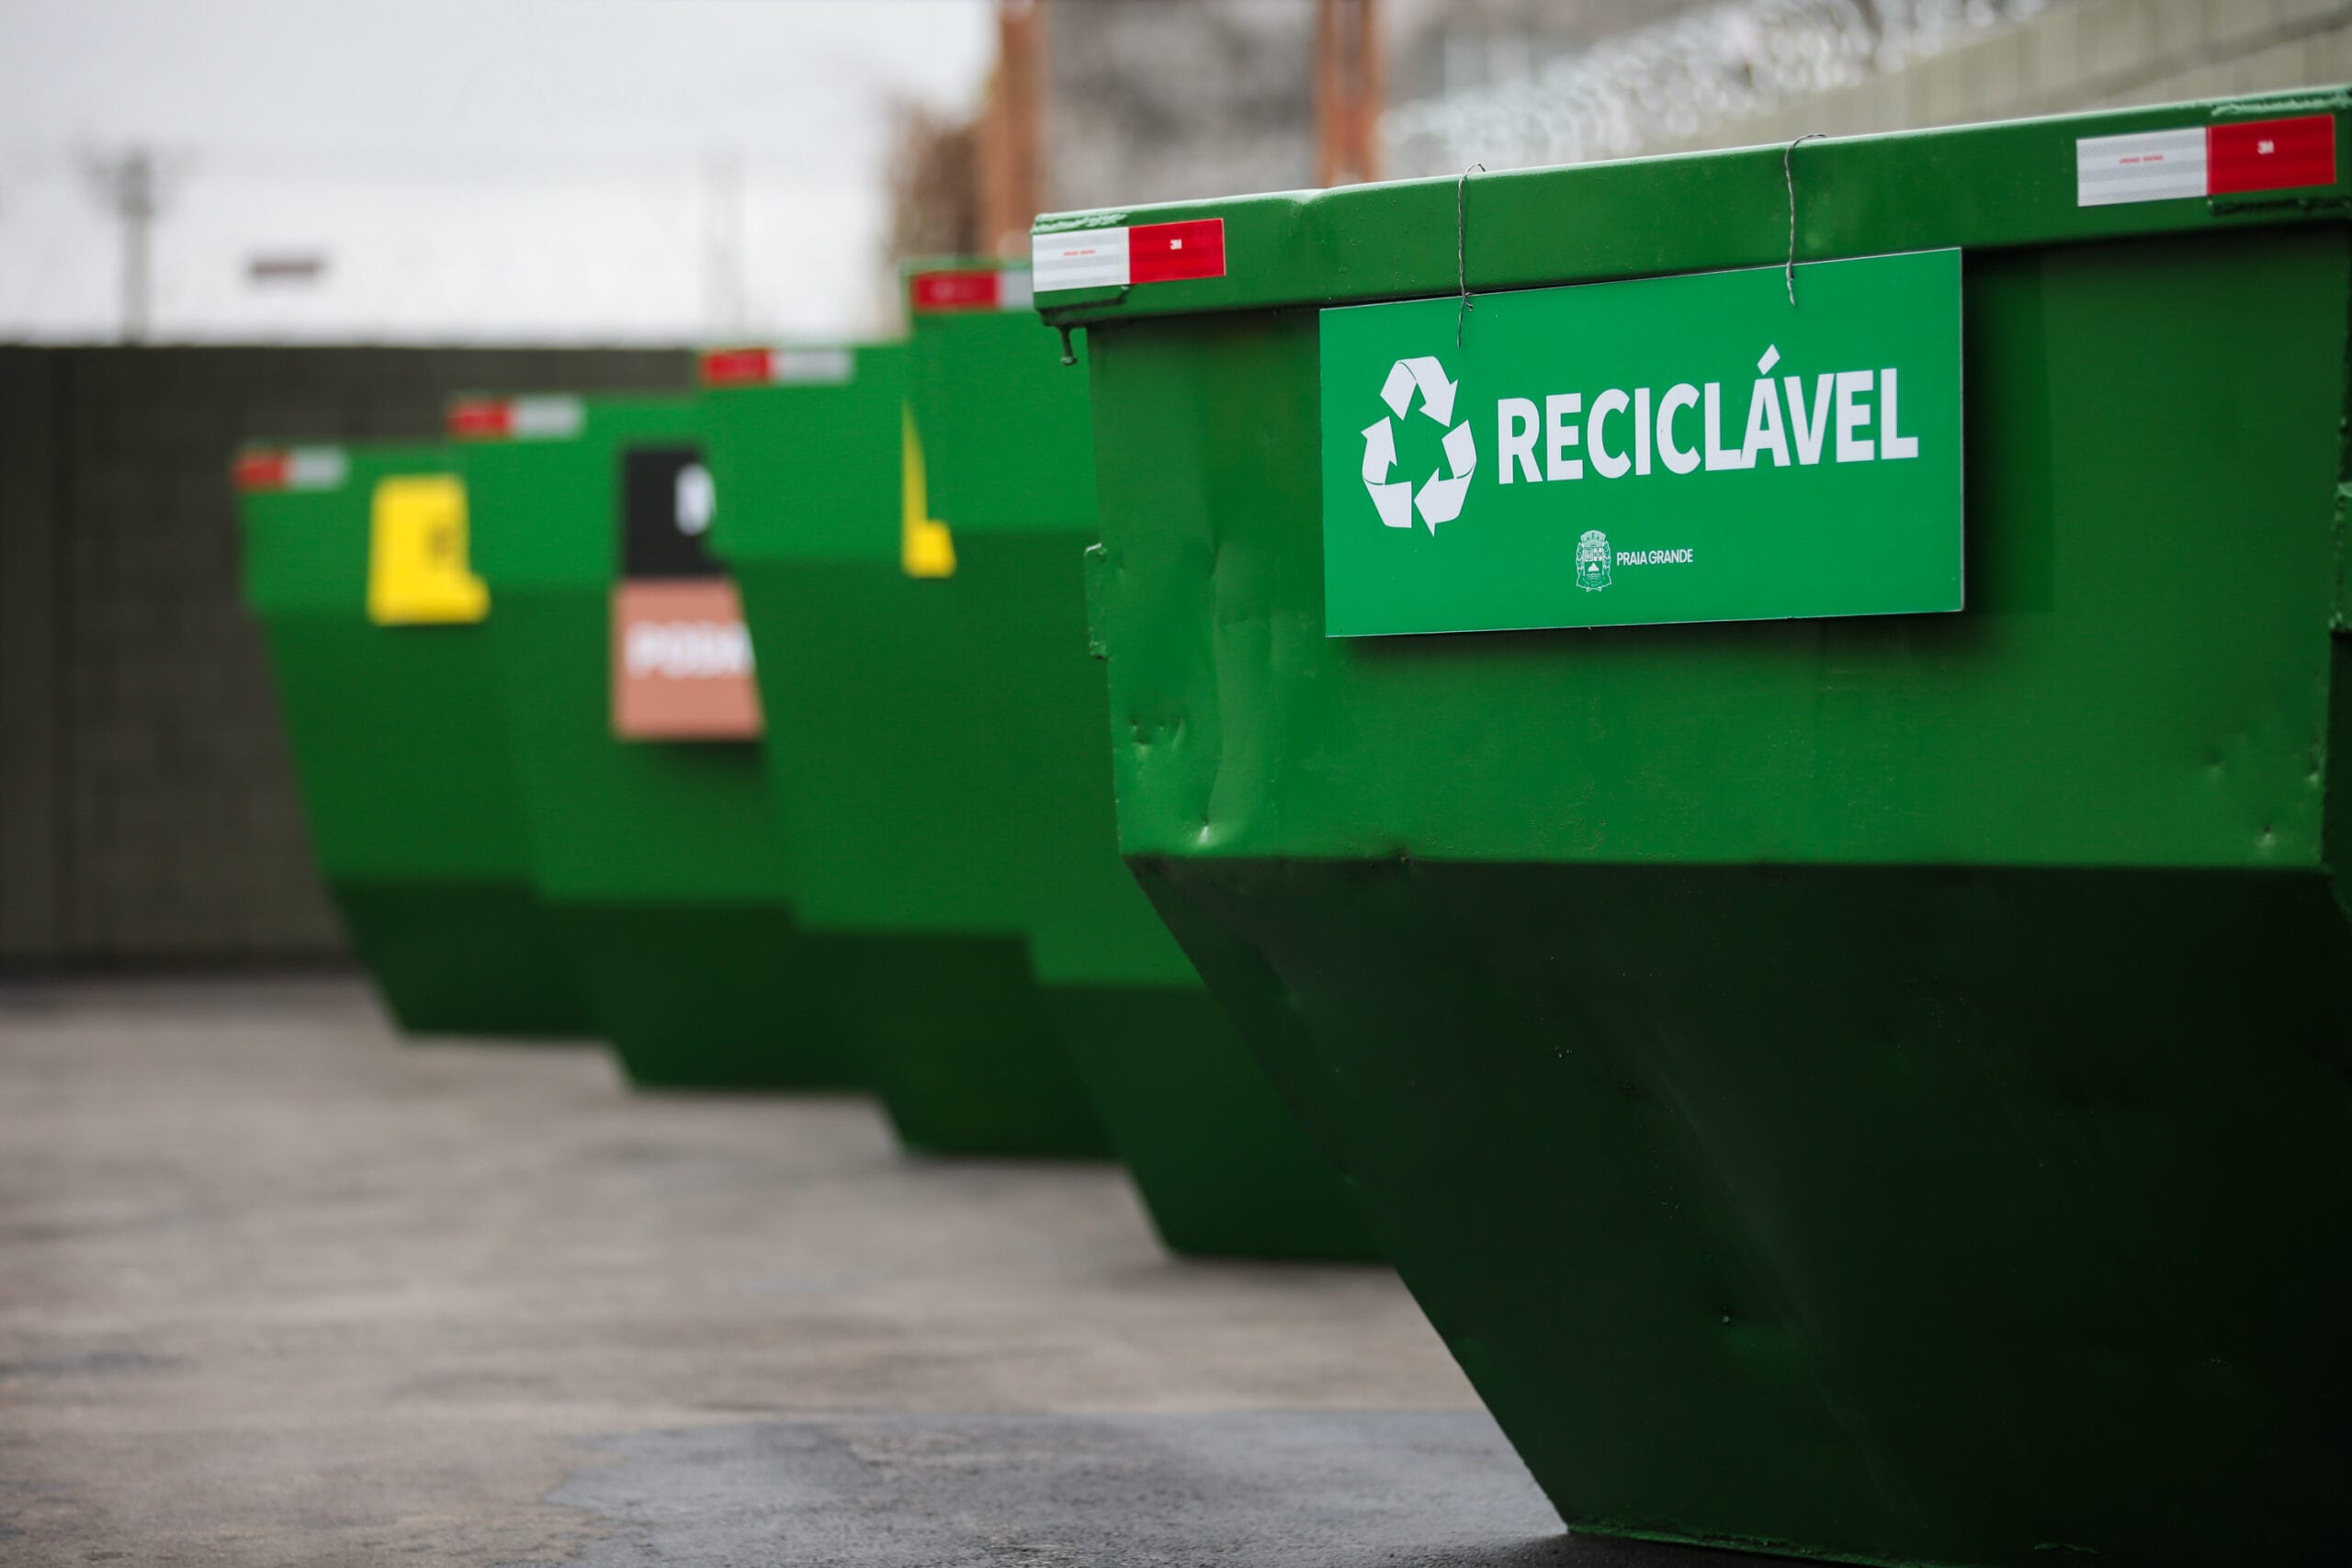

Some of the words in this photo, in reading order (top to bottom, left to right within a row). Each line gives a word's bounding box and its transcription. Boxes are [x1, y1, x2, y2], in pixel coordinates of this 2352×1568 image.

[1498, 344, 1918, 484] RECICLÁVEL
[1616, 551, 1647, 566] PRAIA
[1648, 548, 1693, 564] GRANDE
